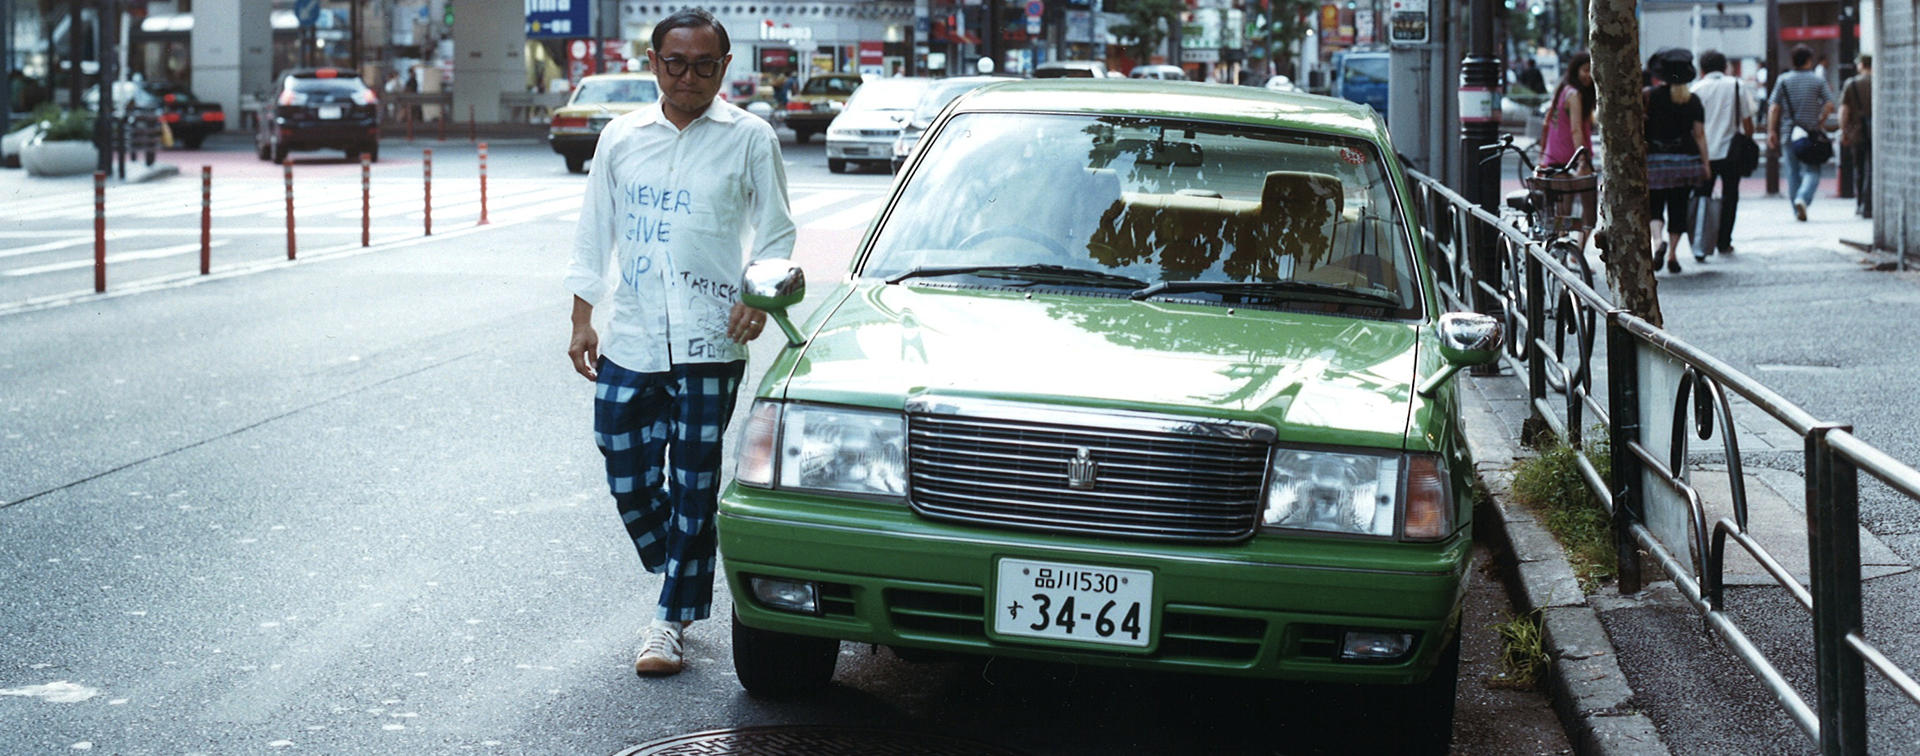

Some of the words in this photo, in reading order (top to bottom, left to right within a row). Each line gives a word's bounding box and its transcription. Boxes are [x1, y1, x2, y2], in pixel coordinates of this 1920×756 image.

[625, 184, 691, 214] NEVER
[626, 213, 672, 243] GIVE
[1007, 600, 1024, 620] す
[1030, 594, 1141, 640] 34-64
